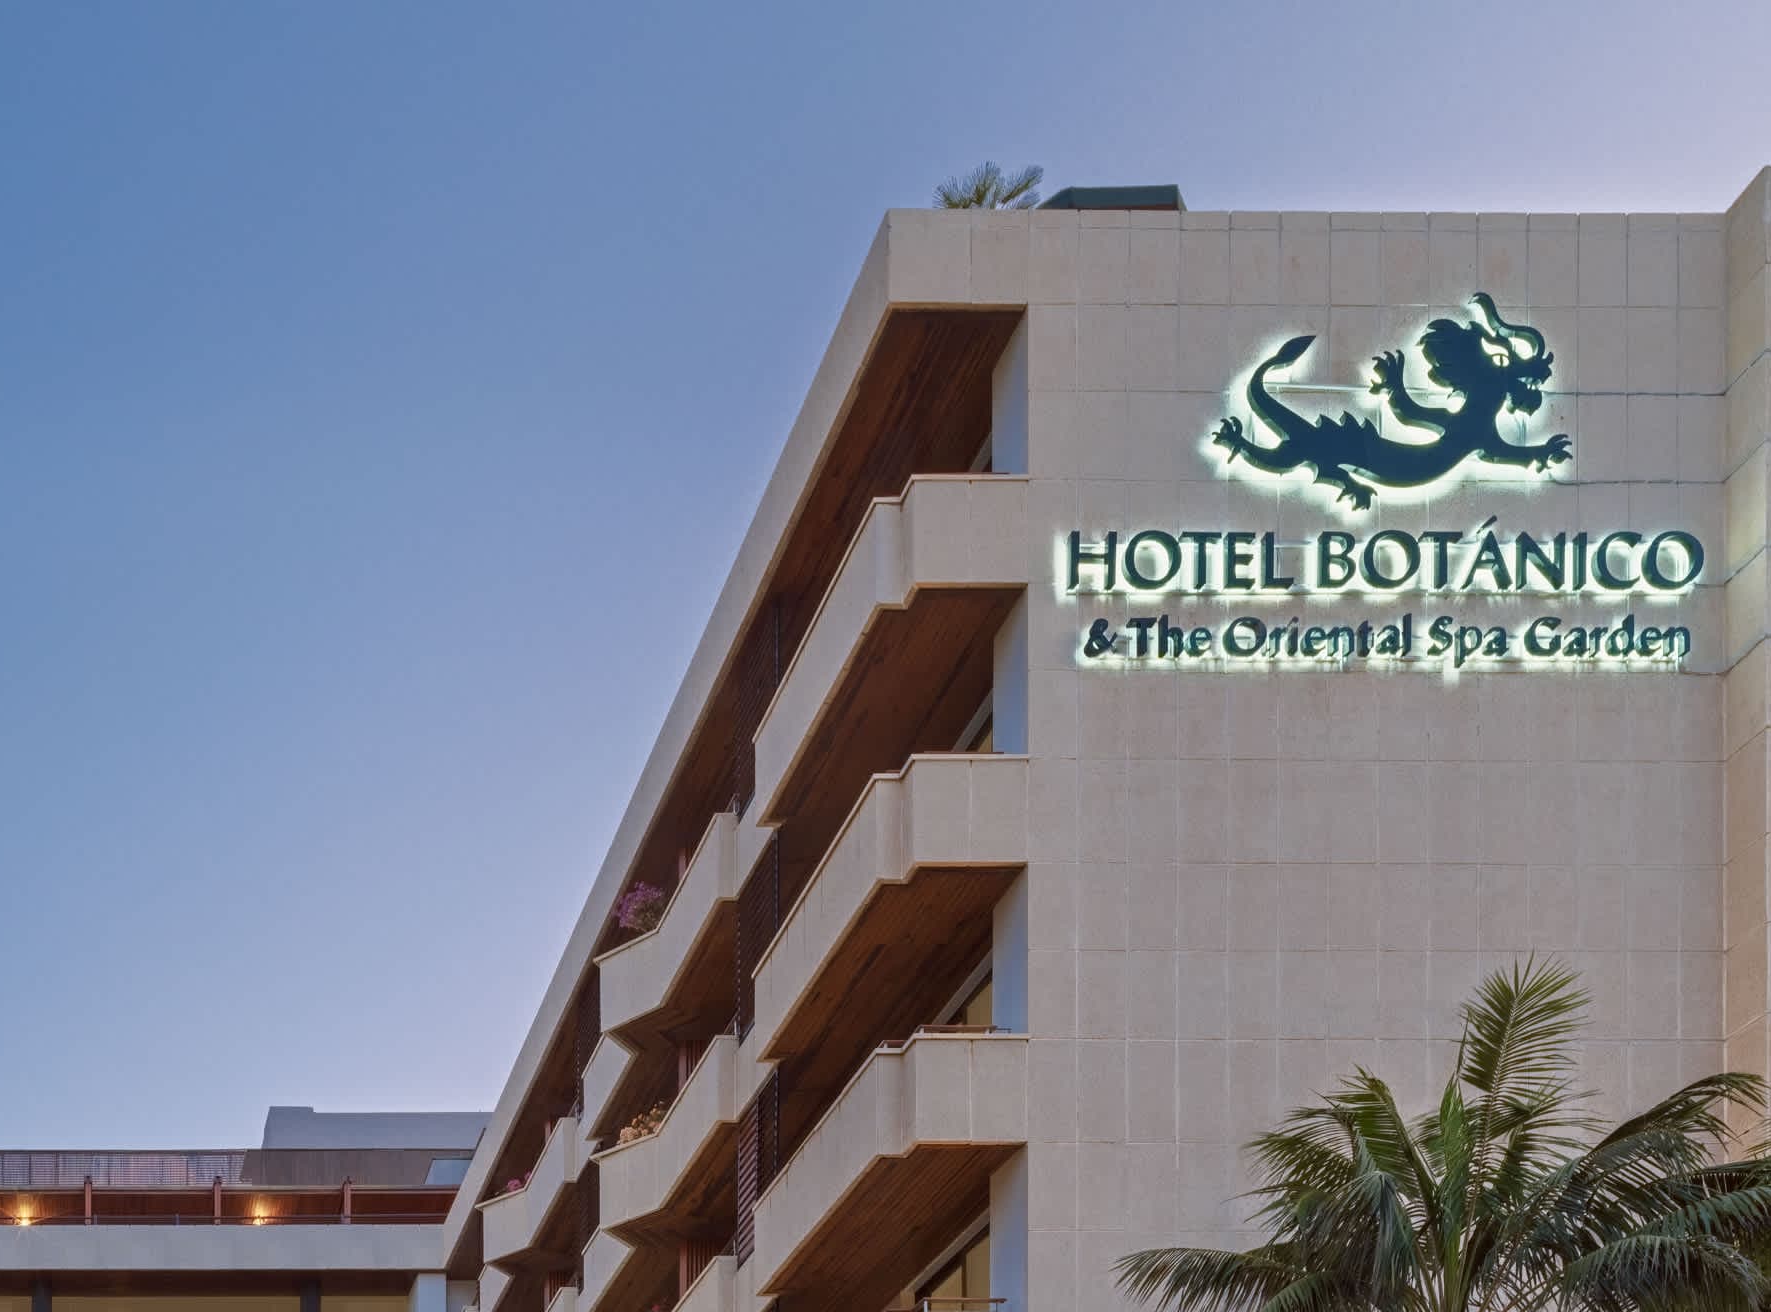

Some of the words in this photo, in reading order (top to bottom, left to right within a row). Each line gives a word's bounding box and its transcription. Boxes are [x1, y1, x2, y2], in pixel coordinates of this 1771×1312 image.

[1067, 530, 1295, 591] HOTEL
[1316, 515, 1705, 591] BOTÁNICO
[1083, 617, 1118, 659] &
[1125, 613, 1213, 659] The
[1222, 613, 1413, 659] Oriental
[1427, 614, 1510, 669] Spa
[1523, 613, 1692, 659] Garden
